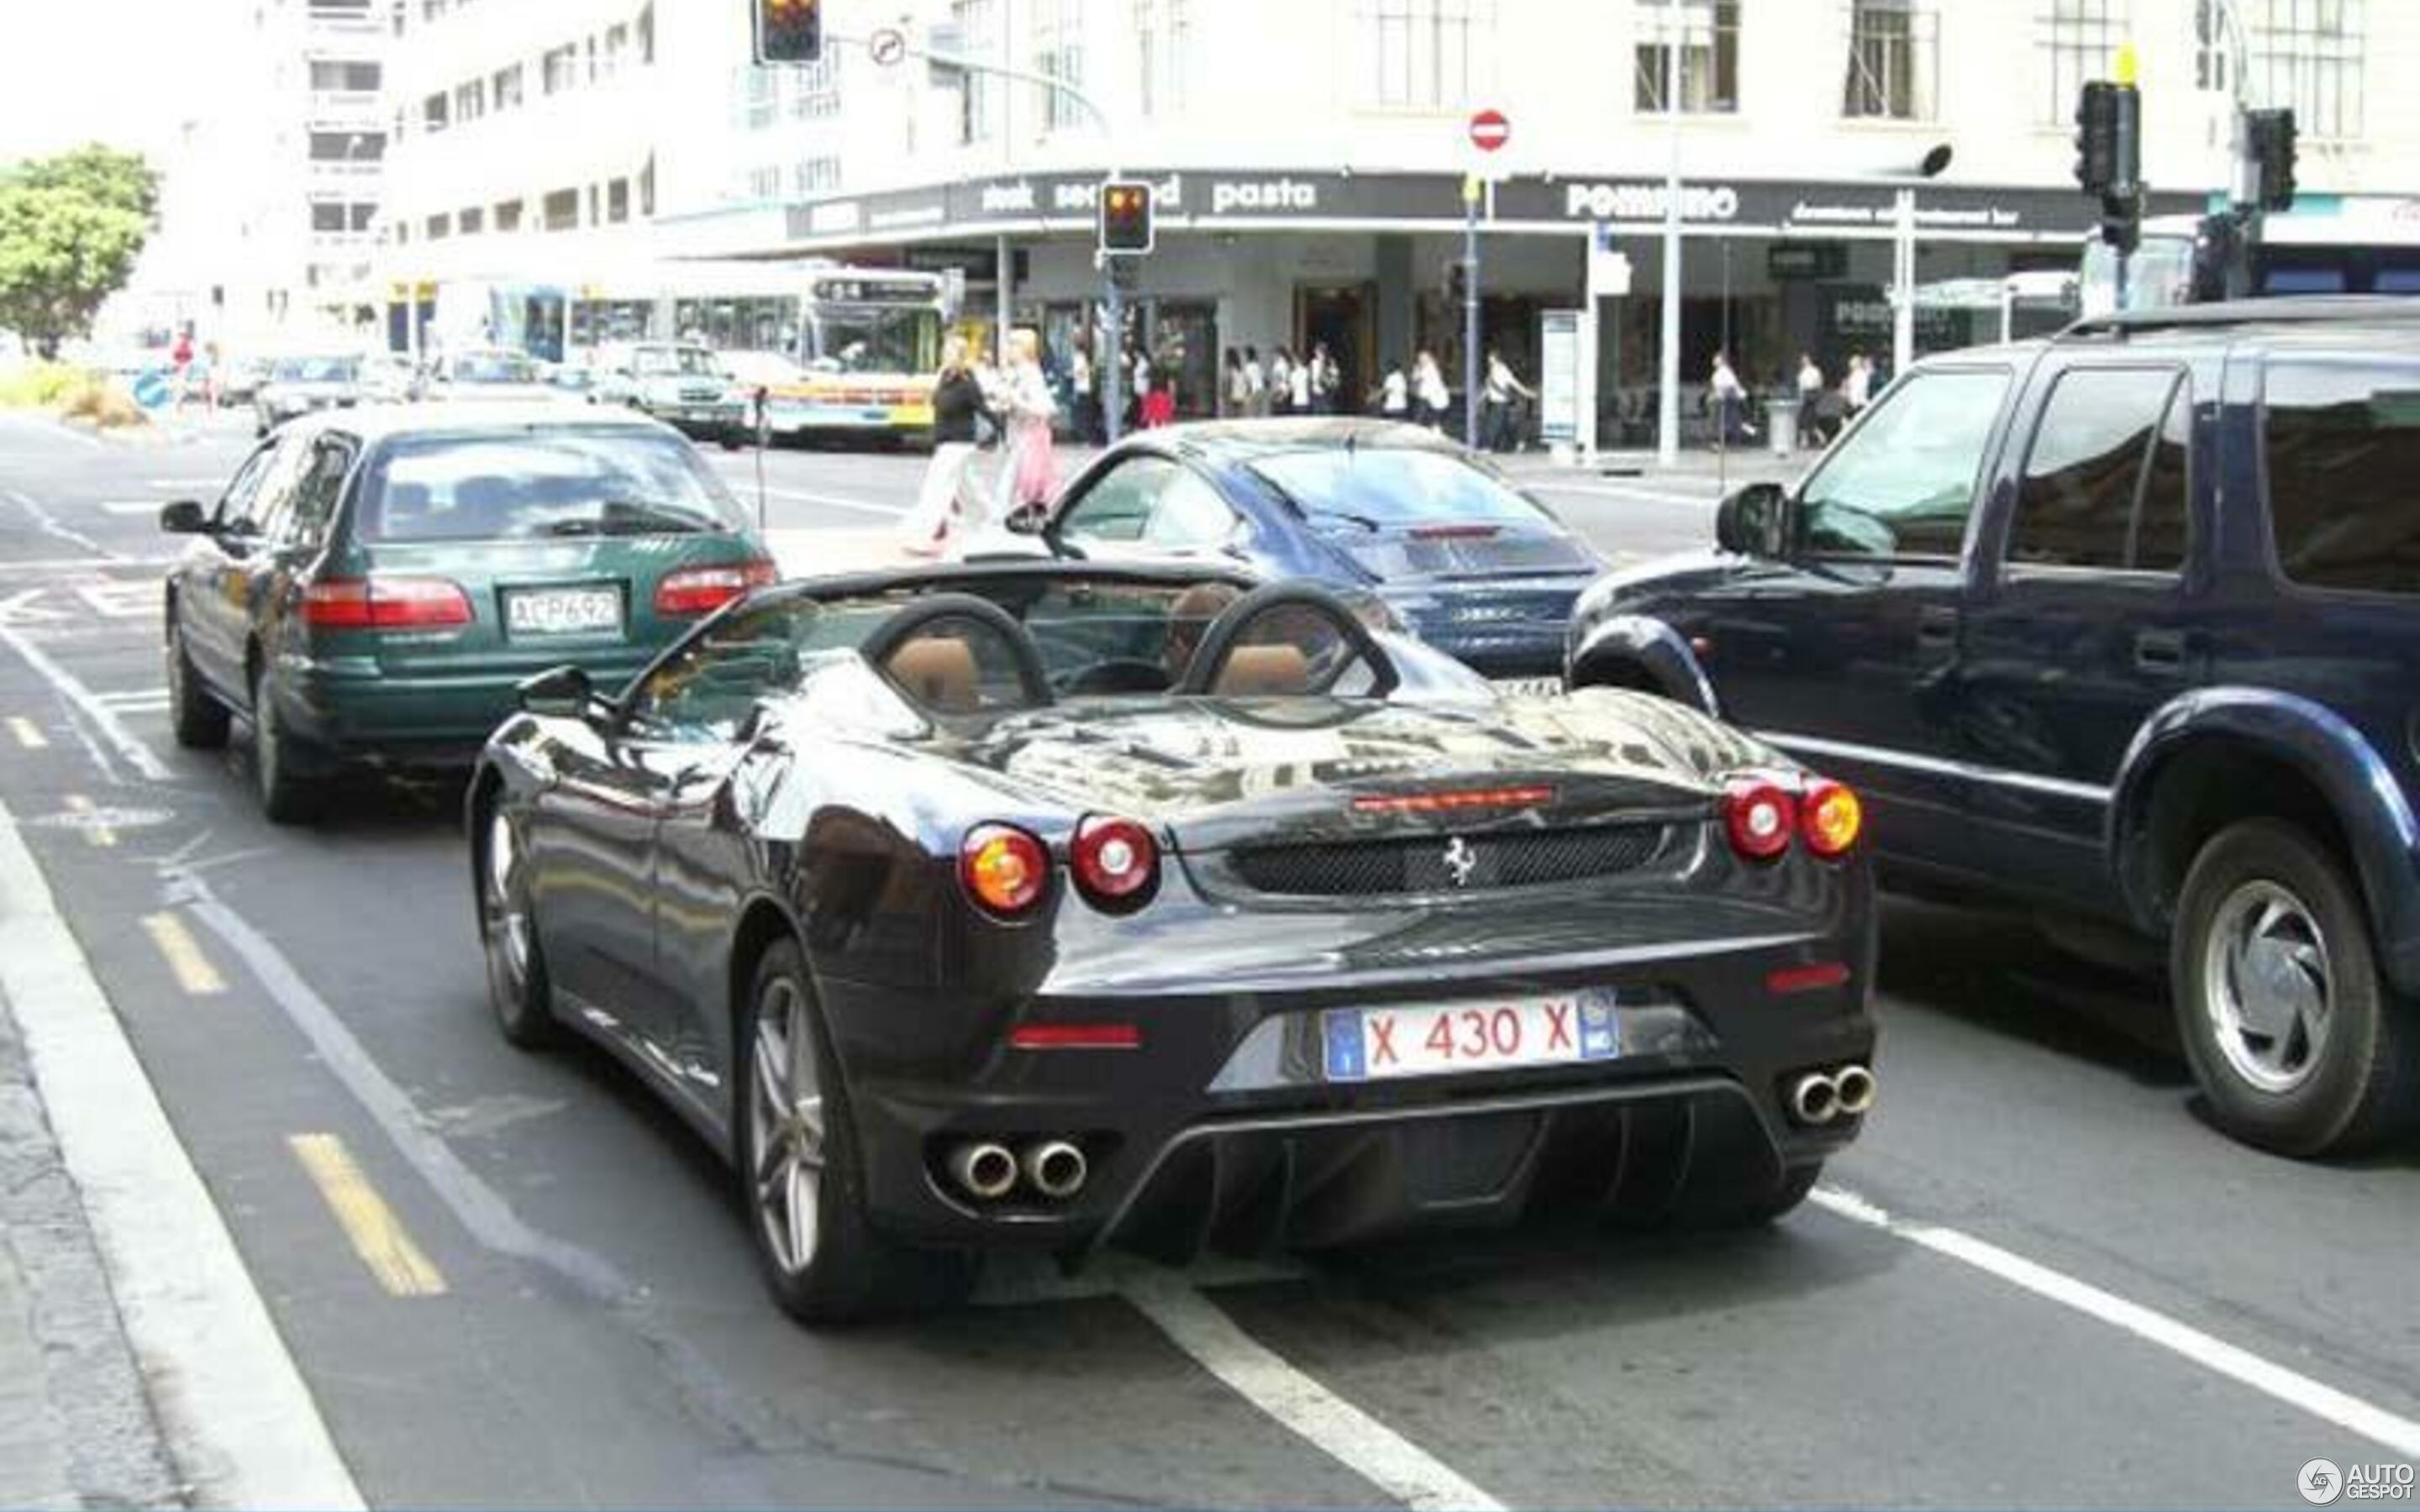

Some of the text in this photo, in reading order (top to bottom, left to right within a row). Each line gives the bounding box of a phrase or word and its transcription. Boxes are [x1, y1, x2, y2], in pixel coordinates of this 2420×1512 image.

[1213, 178, 1316, 213] pasta
[1370, 1015, 1399, 1064] X
[1425, 1008, 1522, 1058] 430
[1545, 1003, 1571, 1050] X
